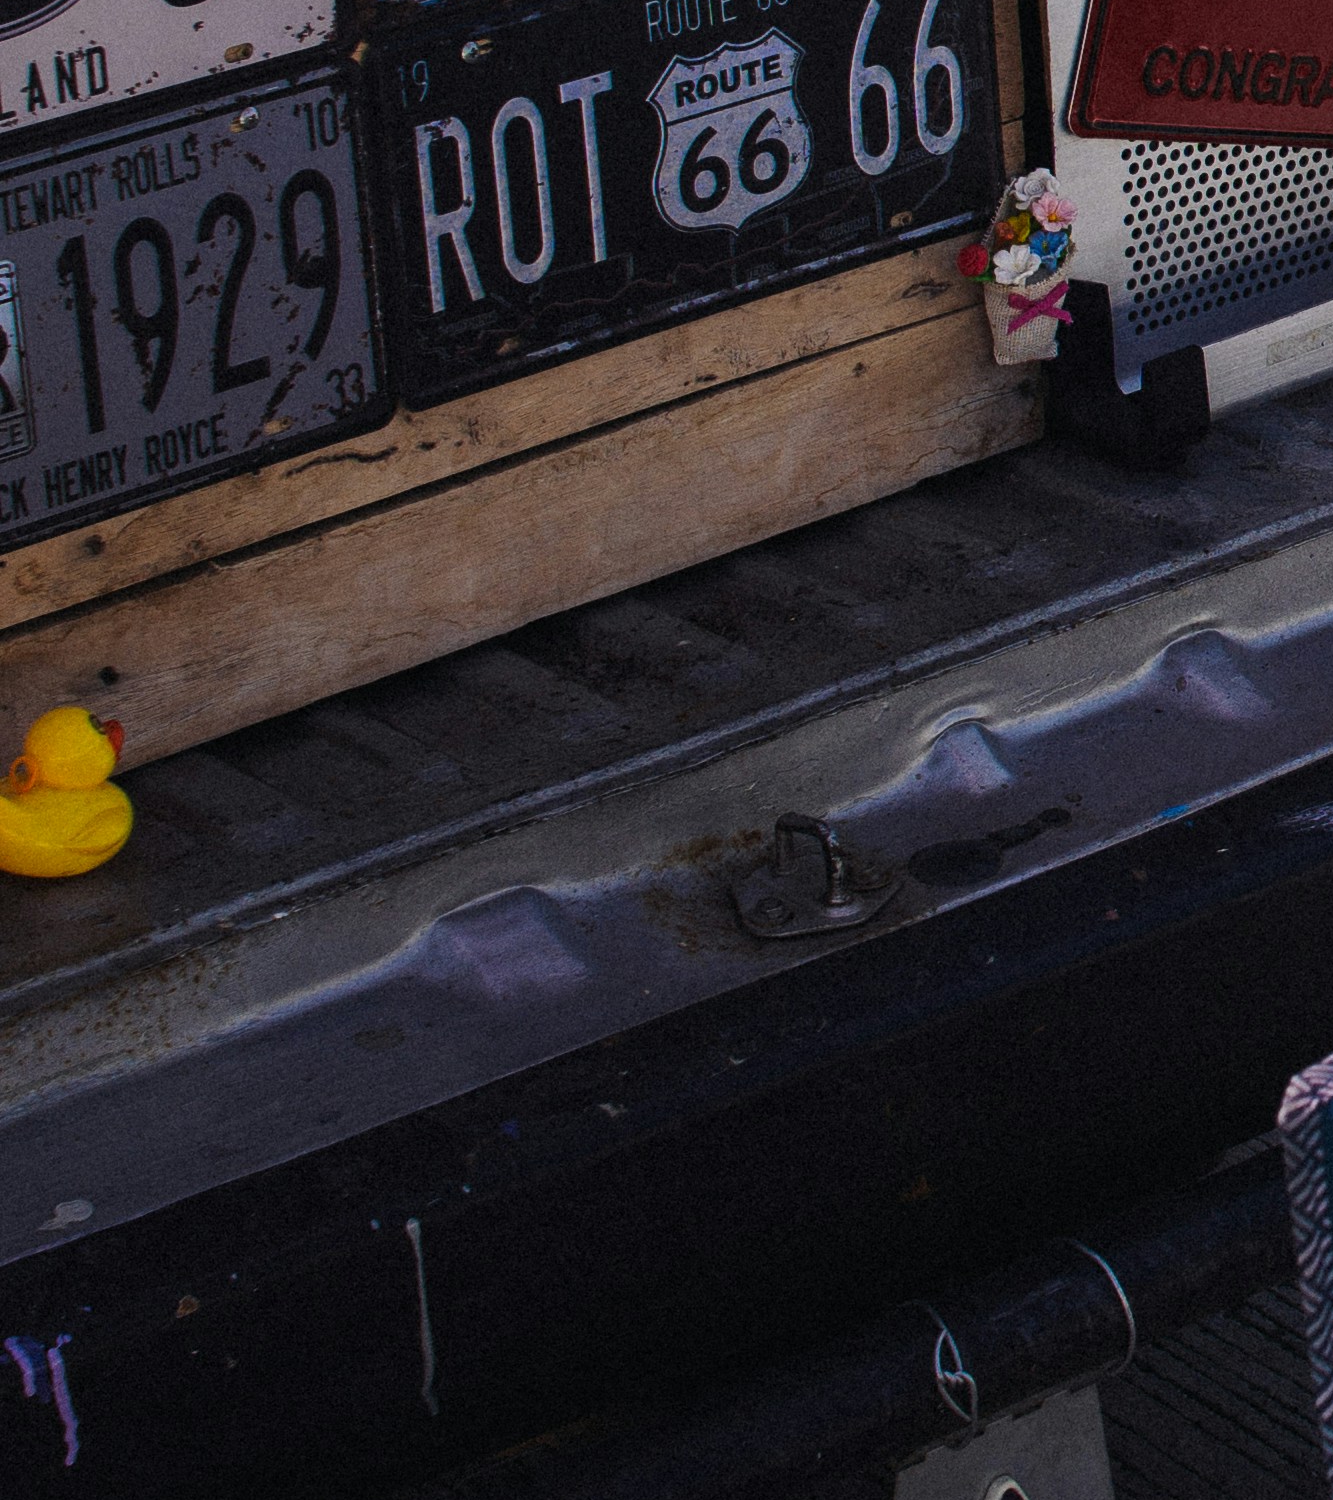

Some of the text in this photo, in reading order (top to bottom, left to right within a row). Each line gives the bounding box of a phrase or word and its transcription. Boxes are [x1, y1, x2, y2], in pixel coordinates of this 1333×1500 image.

[303, 98, 340, 152] 10
[674, 54, 784, 108] ROUTE
[114, 132, 200, 202] ROLLS
[415, 70, 613, 315] ROT
[680, 107, 791, 214] 66
[57, 168, 341, 434] 1929
[43, 444, 128, 507] HENRY
[143, 412, 229, 476] ROYCE
